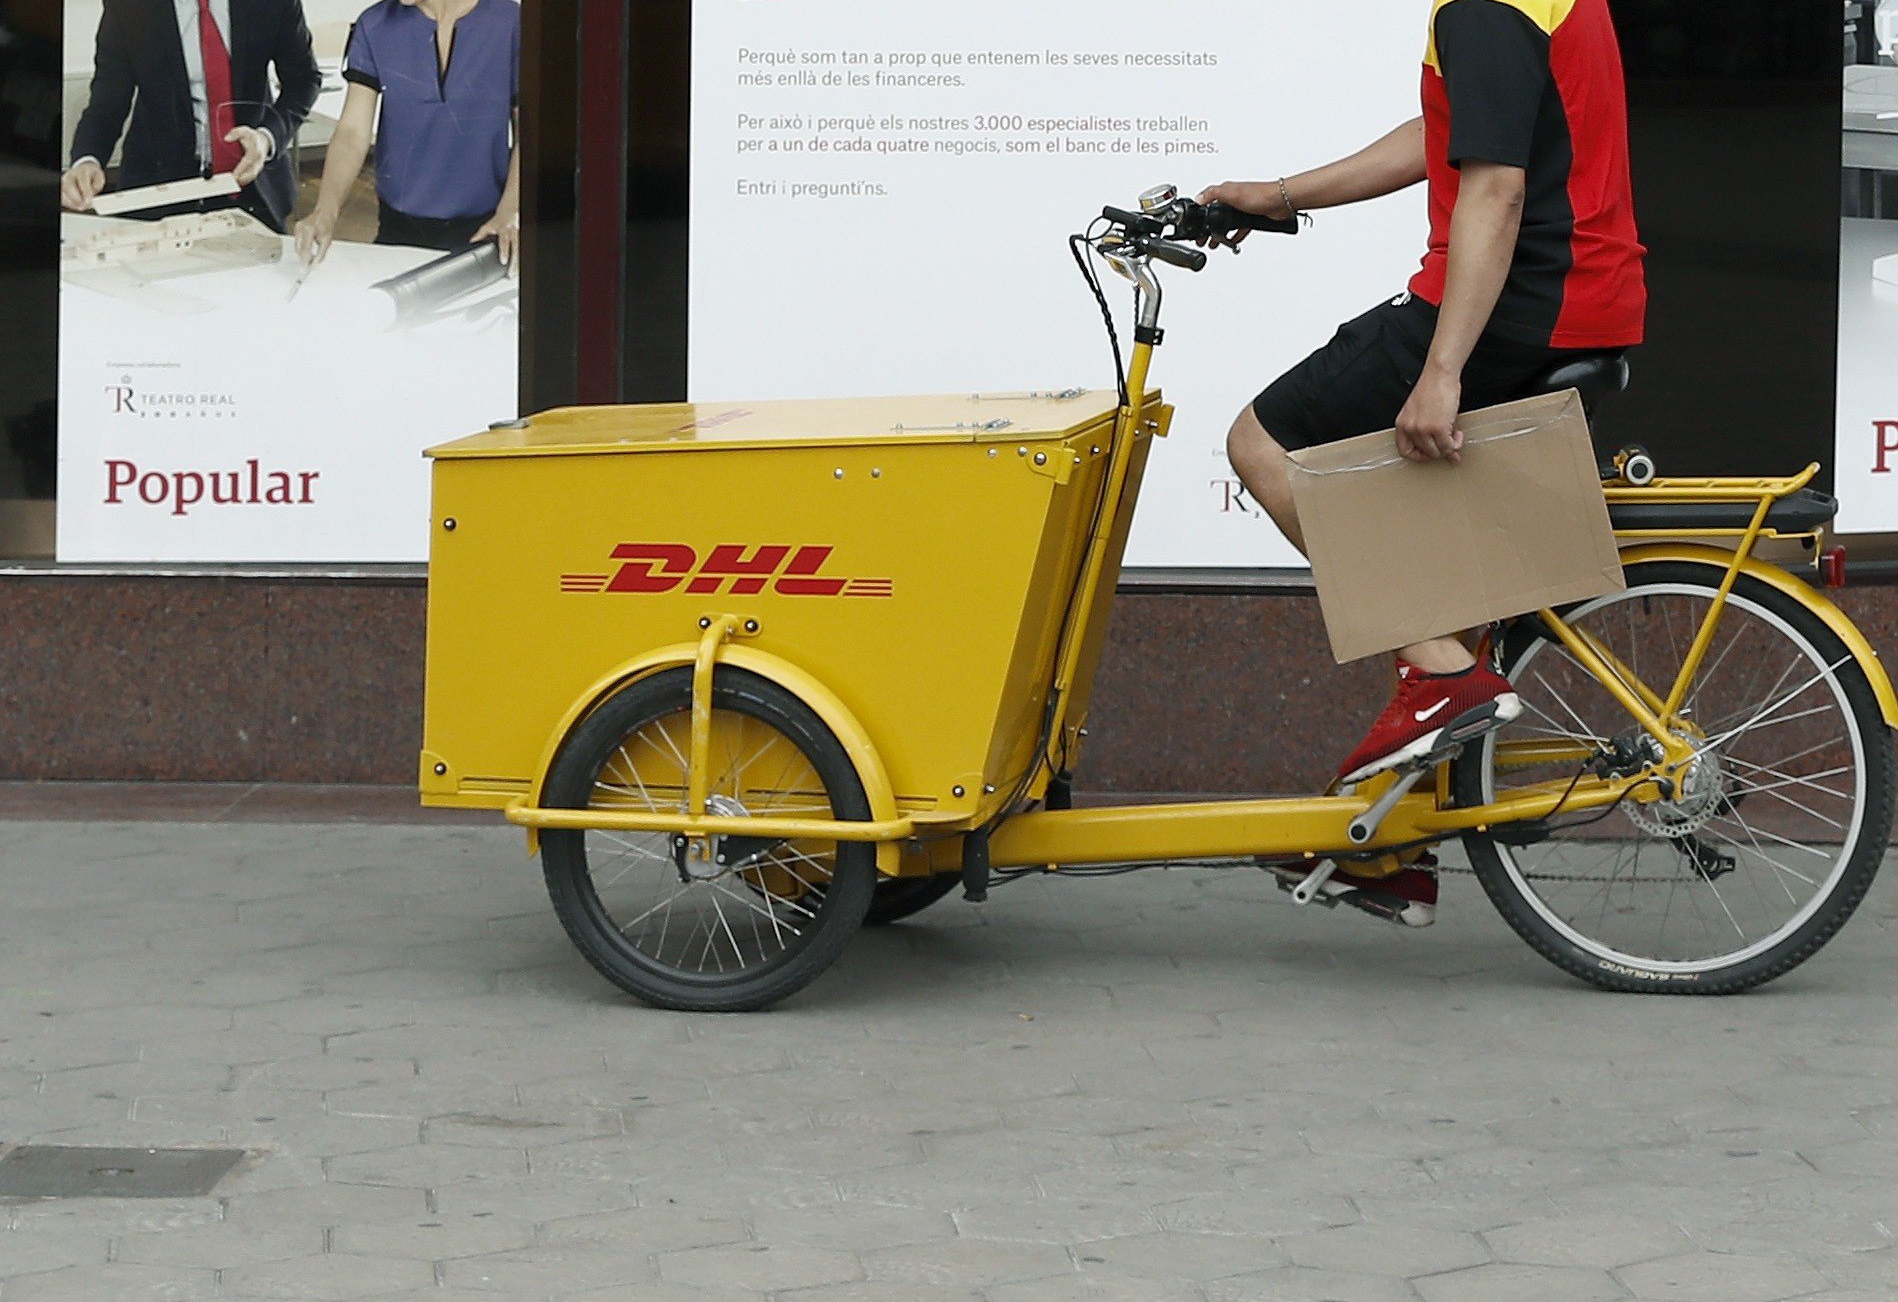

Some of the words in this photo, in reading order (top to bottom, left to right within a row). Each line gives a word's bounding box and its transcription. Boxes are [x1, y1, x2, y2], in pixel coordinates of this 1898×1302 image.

[738, 48, 796, 67] Perquè
[801, 53, 836, 65] som
[842, 50, 868, 65] tan
[874, 53, 883, 65] a
[889, 53, 926, 68] prop
[931, 53, 962, 68] que
[967, 51, 1040, 65] entenem
[1046, 49, 1068, 65] les
[1073, 54, 1119, 66] seves
[1125, 51, 1217, 66] necessitats
[738, 70, 772, 86] més
[778, 70, 816, 86] enllà
[822, 70, 842, 86] de
[848, 71, 870, 86] les
[875, 71, 965, 87] financeres.
[738, 114, 765, 130] Per
[769, 114, 803, 130] això
[808, 115, 812, 130] i
[818, 114, 875, 134] perquè
[880, 114, 903, 131] els
[909, 117, 969, 131] nostres
[974, 115, 1023, 131] 3.000
[1027, 115, 1131, 135] especialistes
[1136, 116, 1208, 131] treballen
[737, 139, 764, 154] per
[768, 140, 778, 152] a
[783, 140, 803, 152] un
[808, 136, 828, 152] de
[833, 136, 872, 152] cada
[877, 139, 929, 156] quatre
[935, 137, 1000, 155] negocis,
[1005, 141, 1040, 153] som
[1046, 137, 1060, 153] el
[1066, 137, 1106, 153] banc
[1111, 137, 1131, 153] de
[1137, 137, 1159, 153] les
[1165, 138, 1219, 156] pimes.
[737, 179, 776, 196] Entri
[782, 180, 786, 195] i
[141, 394, 196, 405] TEATRO
[200, 394, 236, 406] REAL
[104, 459, 319, 515] Popular
[605, 543, 846, 597] DHL
